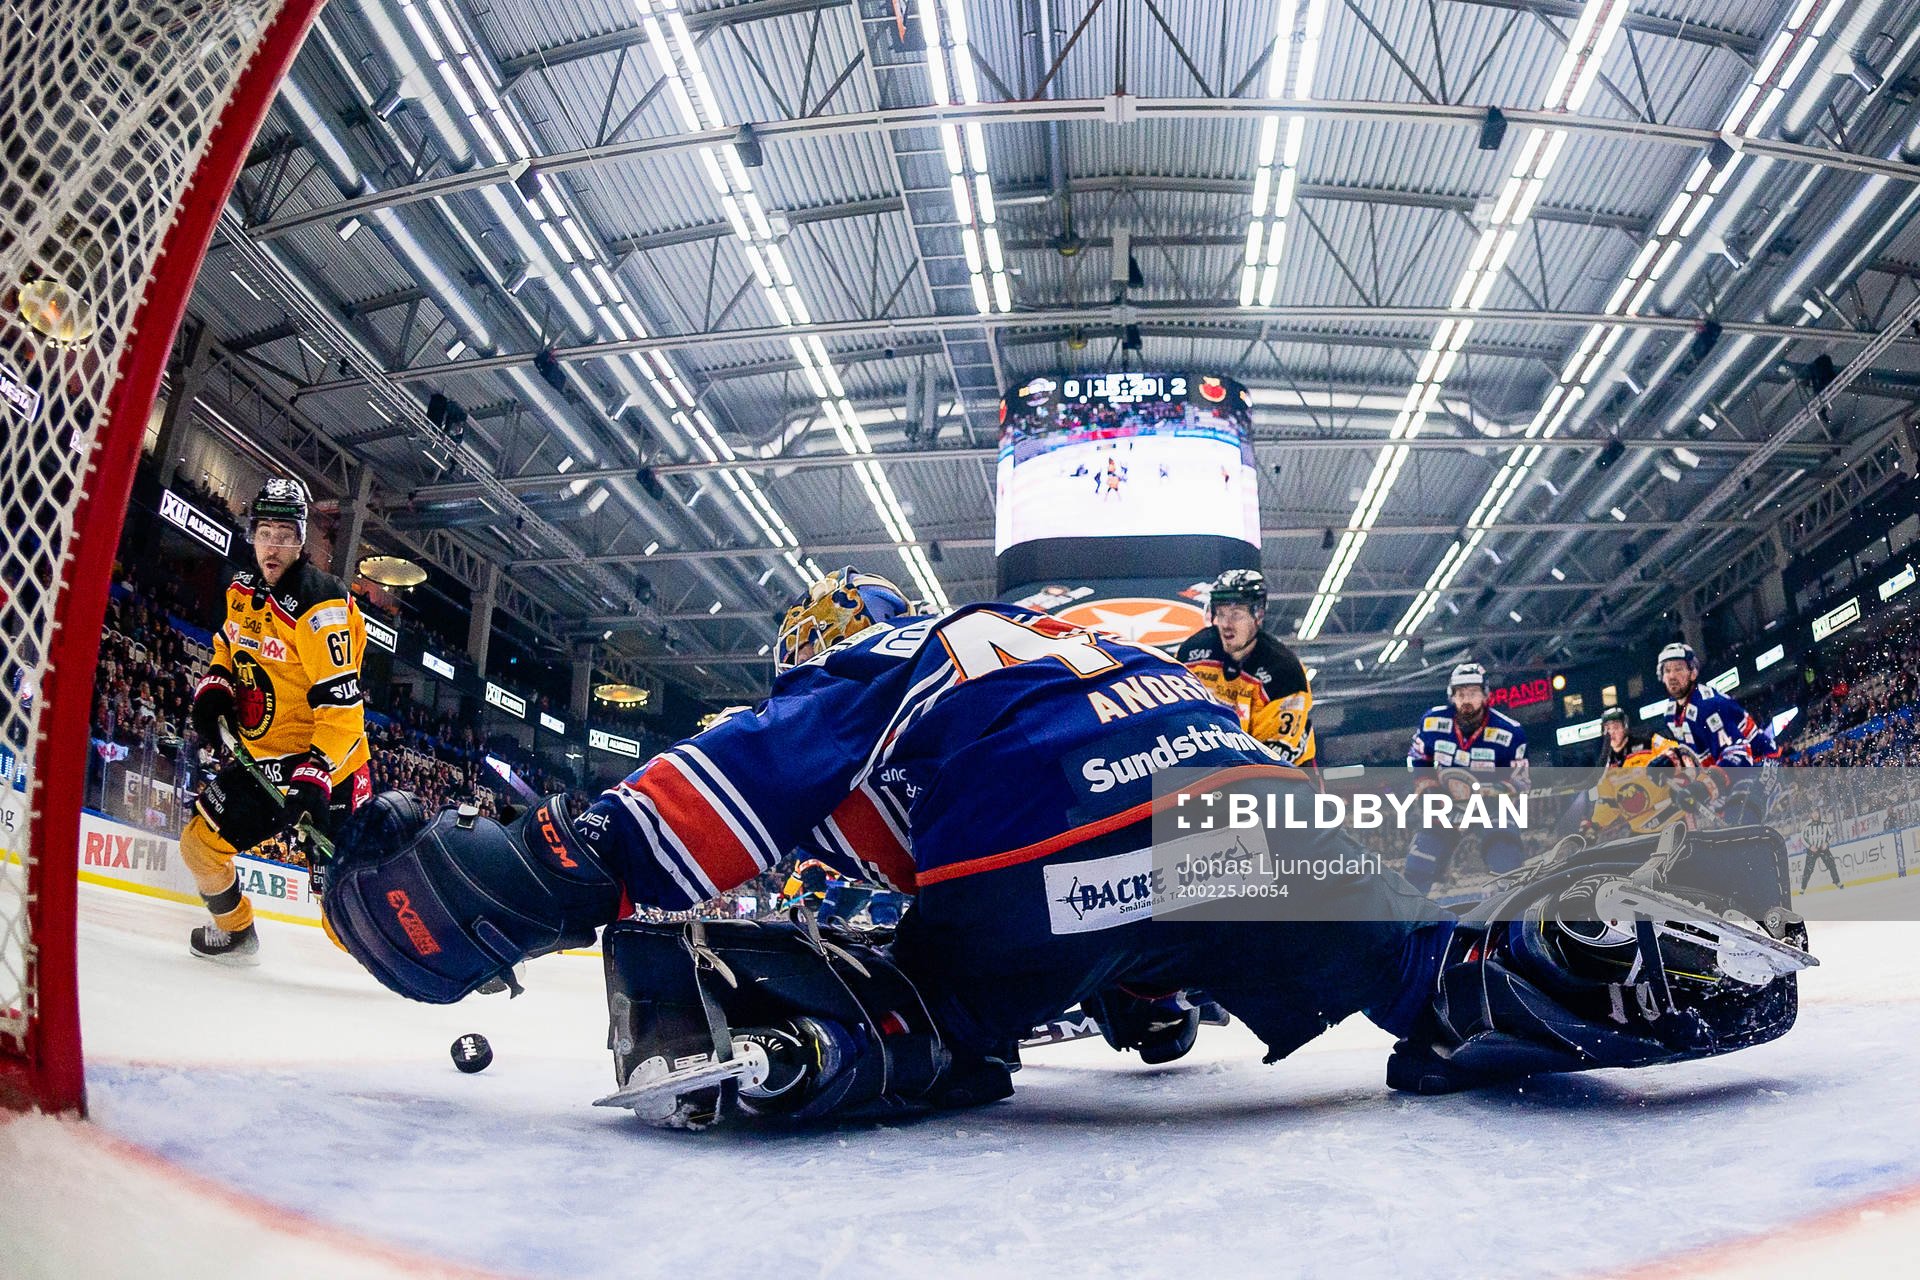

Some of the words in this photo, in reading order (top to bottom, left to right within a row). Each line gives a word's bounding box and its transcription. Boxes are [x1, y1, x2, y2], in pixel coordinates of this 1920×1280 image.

[1064, 380, 1080, 398] 0
[1170, 378, 1187, 396] 2
[186, 514, 227, 549] ALVESTA
[327, 630, 353, 668] 67
[536, 806, 578, 869] CCM
[578, 826, 601, 841] AB
[84, 831, 167, 872] RIXFM
[1020, 1016, 1103, 1046] CM
[460, 1036, 478, 1061] SHL
